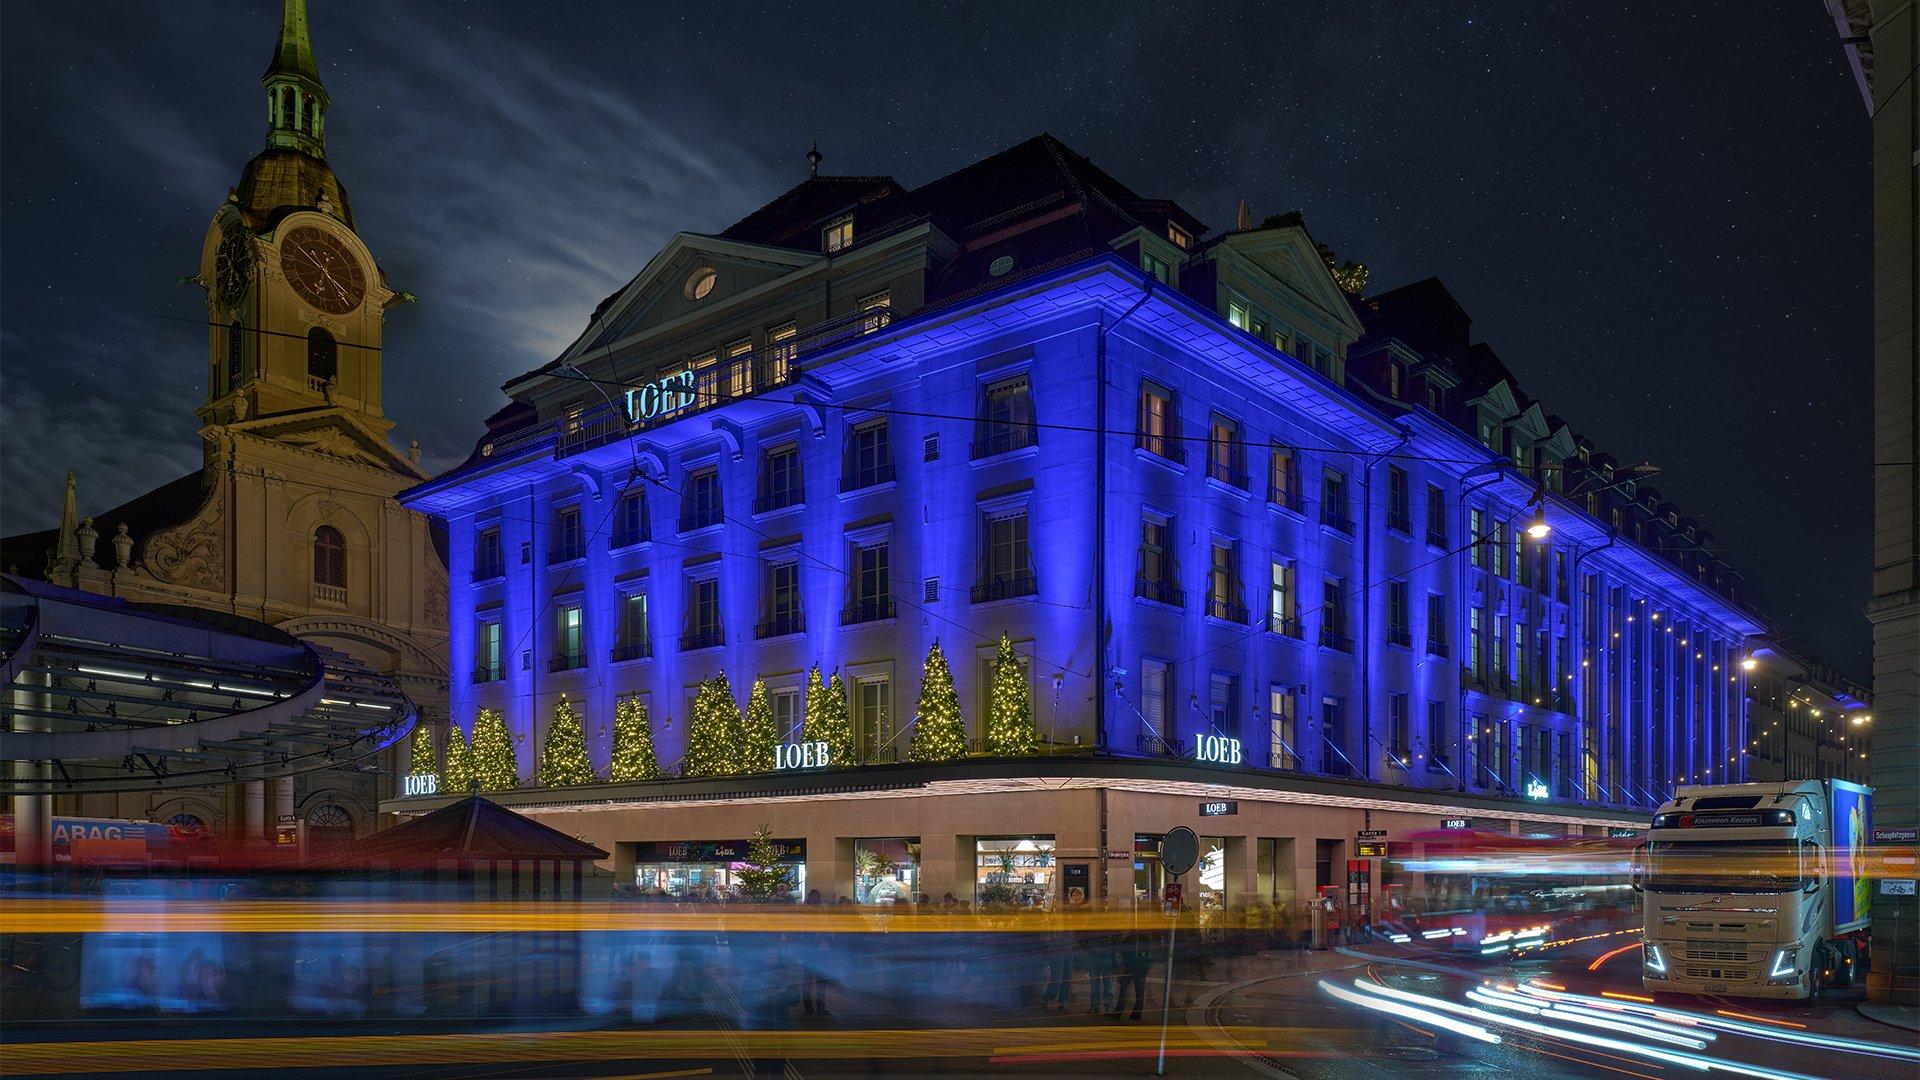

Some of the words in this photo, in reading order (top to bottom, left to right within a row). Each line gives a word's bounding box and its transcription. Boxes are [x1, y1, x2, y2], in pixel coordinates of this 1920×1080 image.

[625, 370, 696, 423] LOEB
[774, 741, 830, 770] LOEB
[1195, 733, 1242, 764] LOEB
[404, 774, 437, 796] LOEB
[1206, 802, 1227, 813] LOEB
[1446, 819, 1466, 828] LOEB
[1694, 816, 1729, 824] Krummen
[1730, 816, 1758, 824] Kerzers
[668, 845, 688, 857] LOEB
